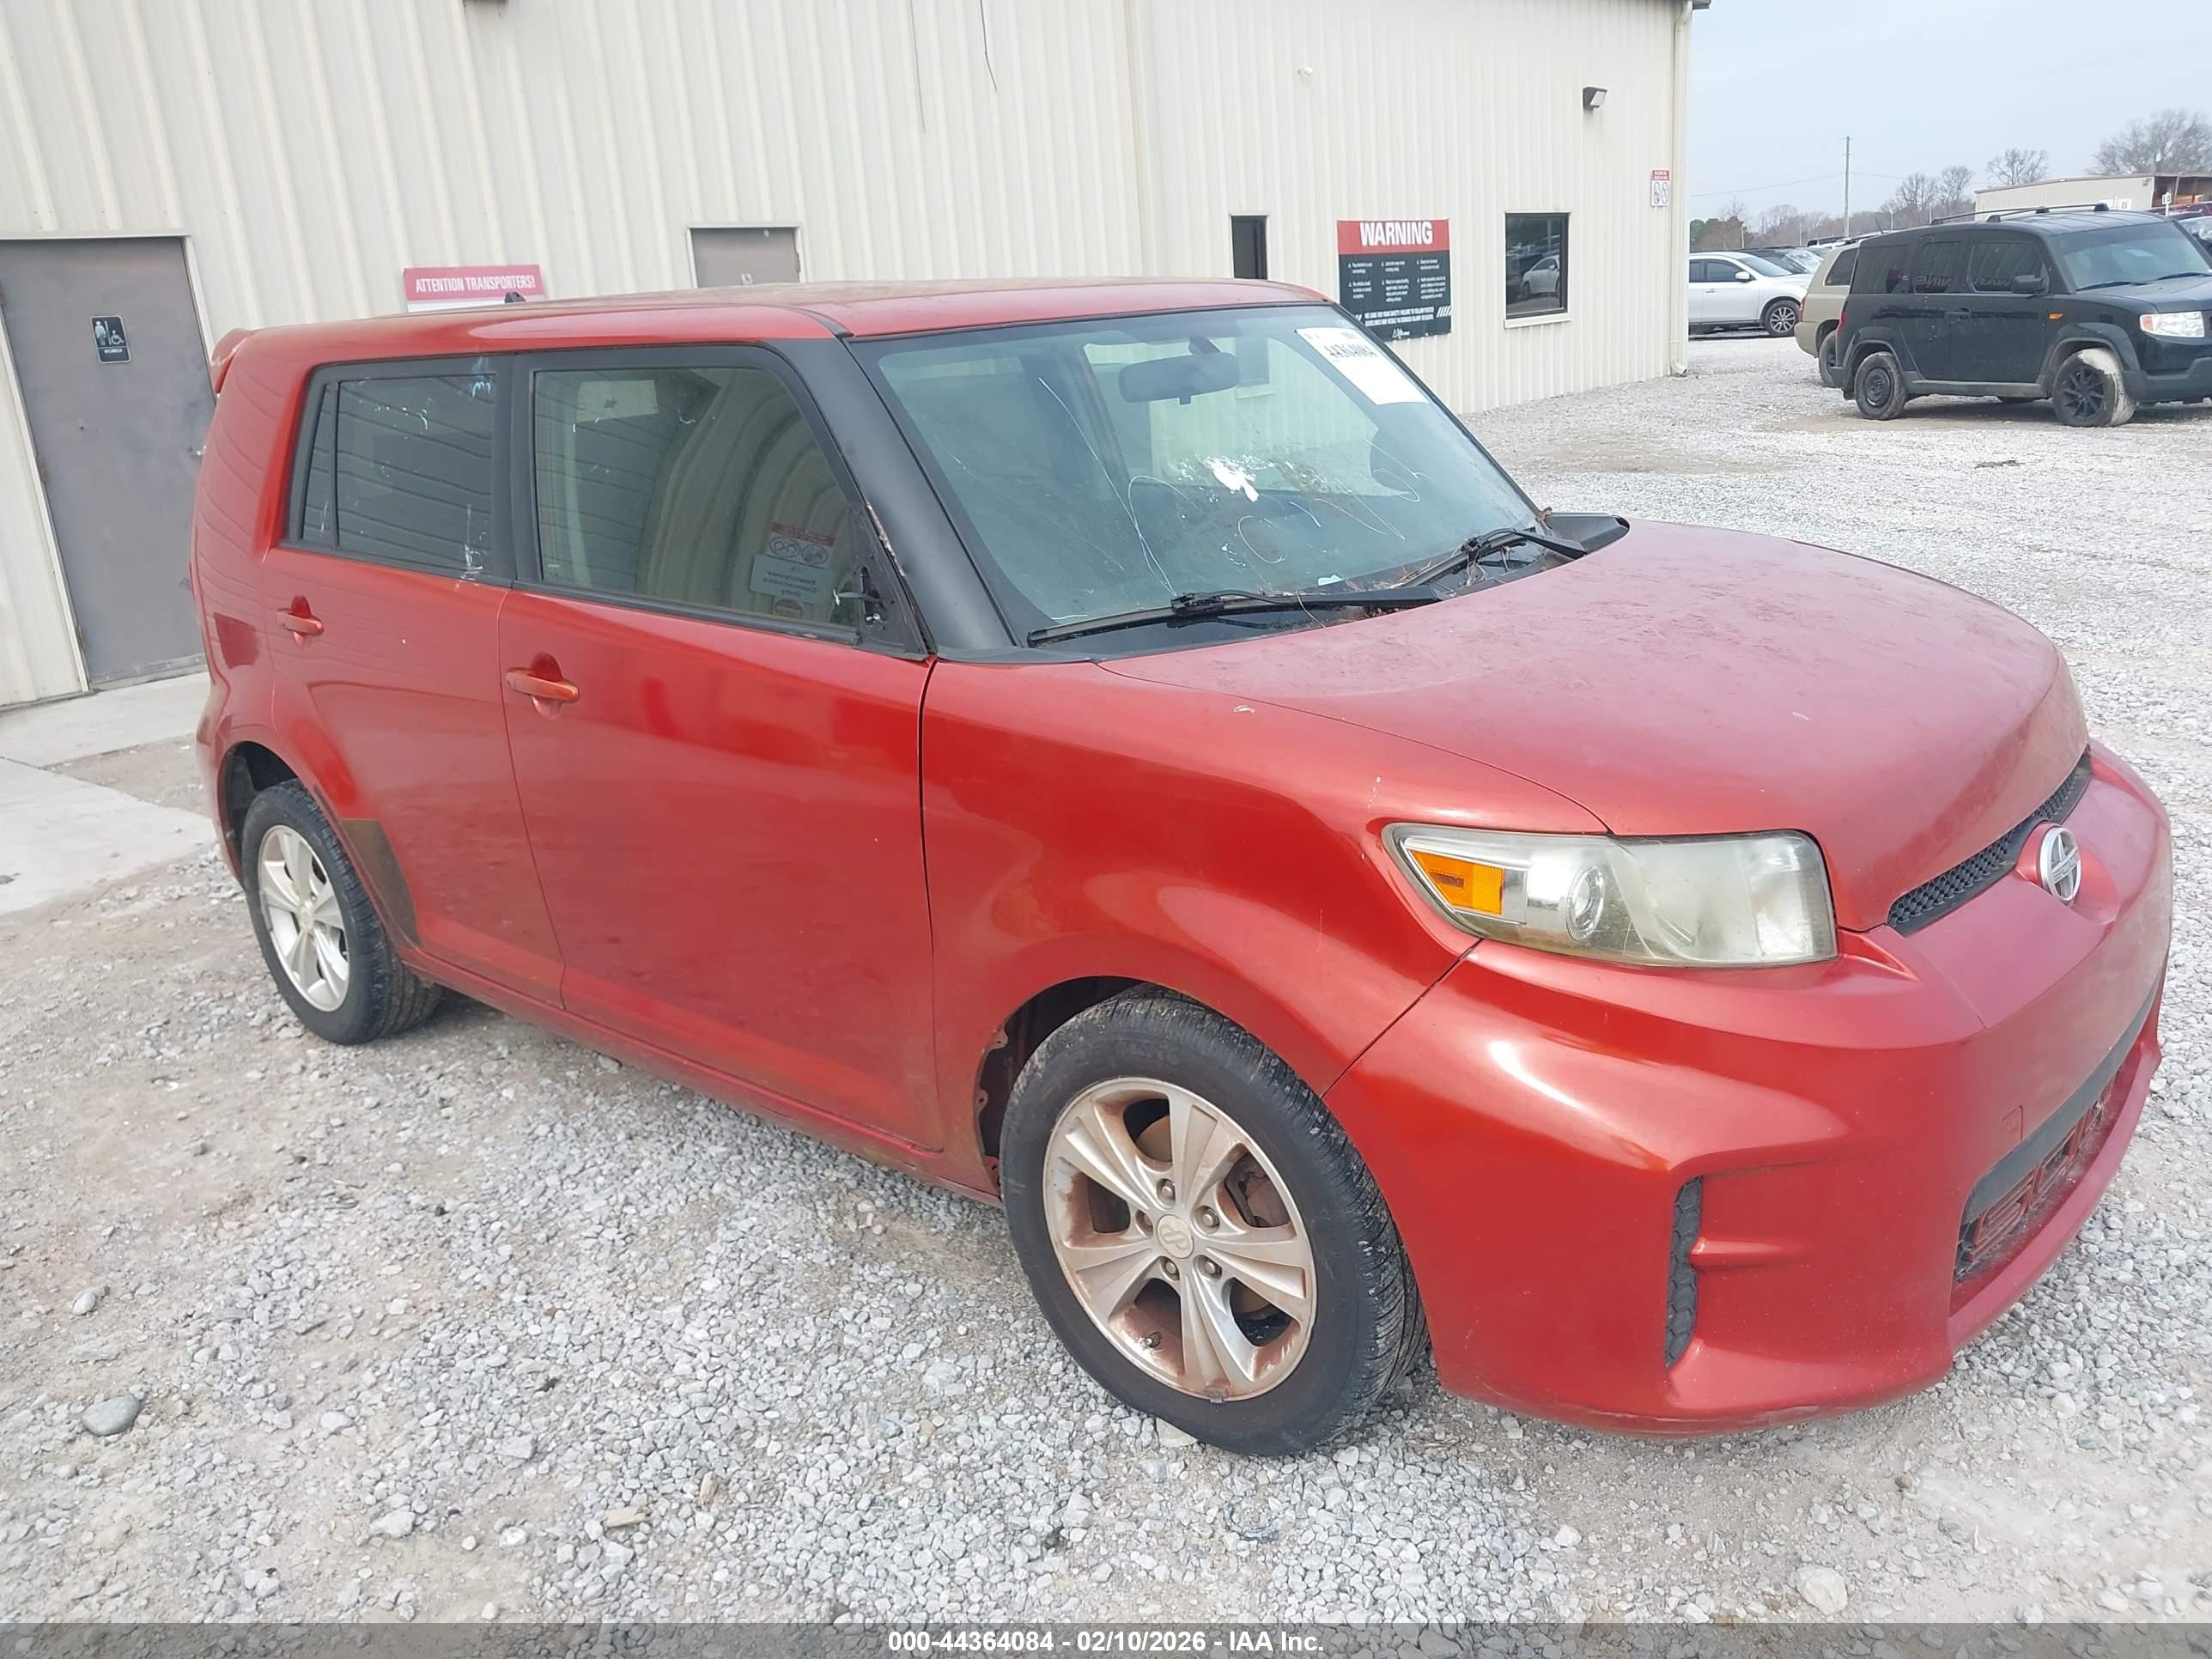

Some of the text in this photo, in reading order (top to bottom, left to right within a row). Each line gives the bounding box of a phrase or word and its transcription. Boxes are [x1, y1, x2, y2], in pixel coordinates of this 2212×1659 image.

[1359, 221, 1433, 246] WARNING
[416, 275, 536, 293] ATTENTION TRANSPORTERS!
